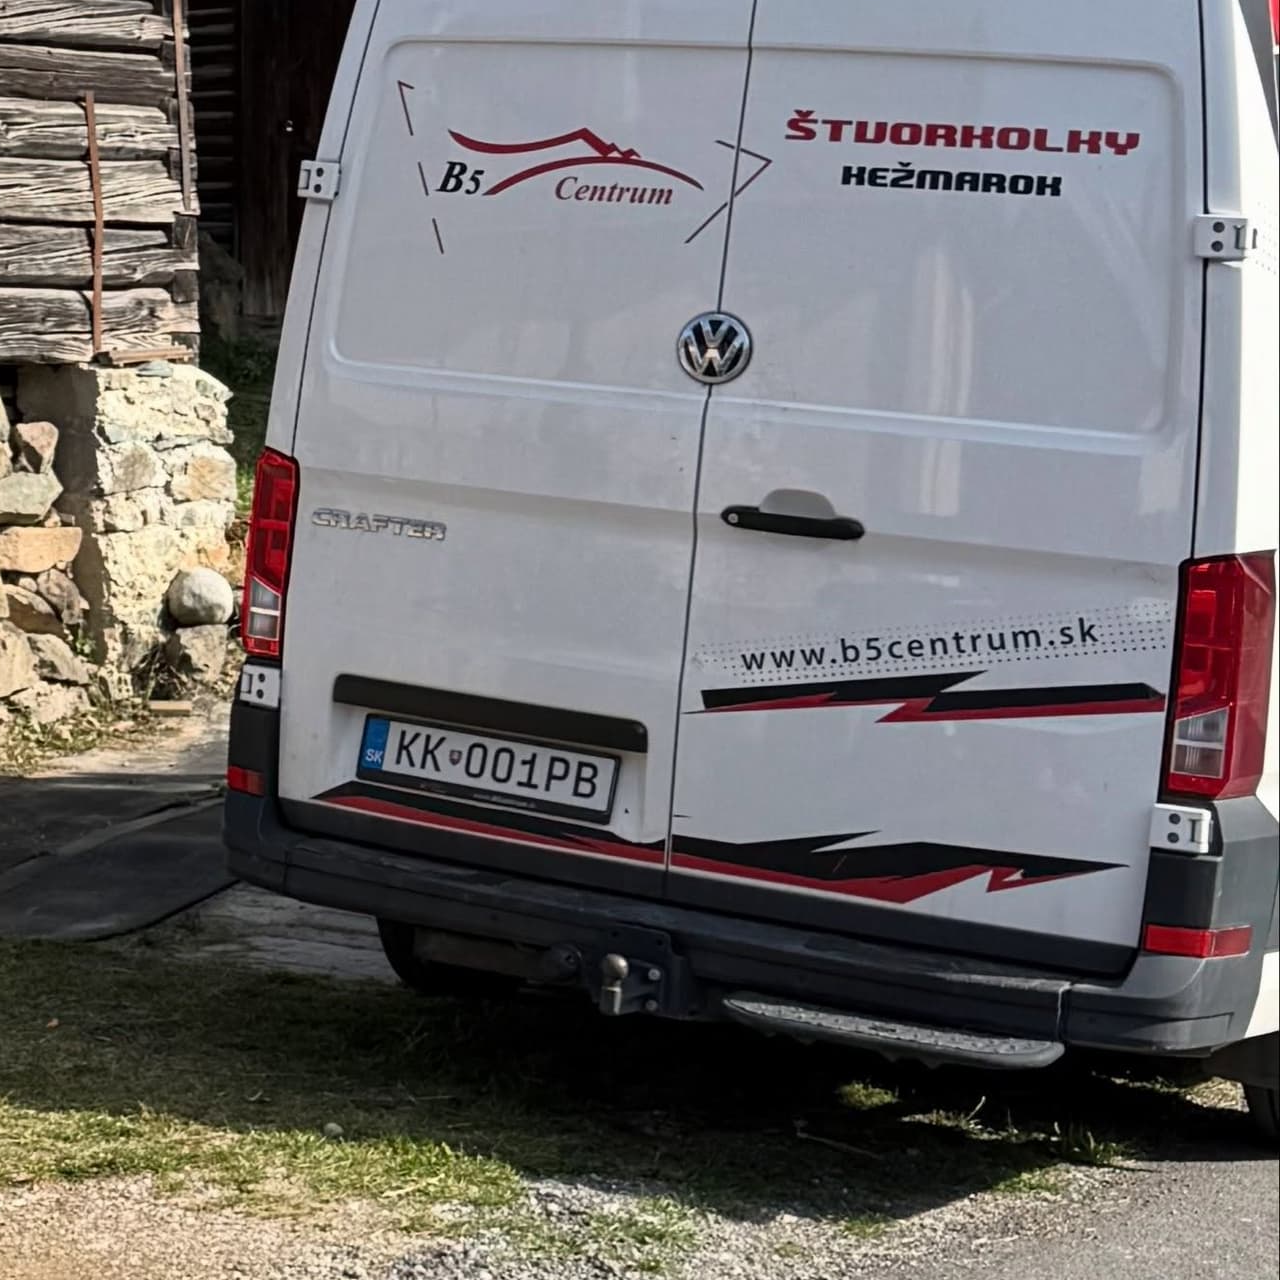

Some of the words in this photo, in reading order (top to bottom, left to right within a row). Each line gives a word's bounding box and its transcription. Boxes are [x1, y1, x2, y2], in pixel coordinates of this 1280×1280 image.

[435, 161, 485, 195] B5
[554, 176, 673, 205] Centrum
[312, 508, 447, 541] CRAFTER
[741, 617, 1099, 671] www.b5centrum.sk
[365, 748, 384, 763] SK
